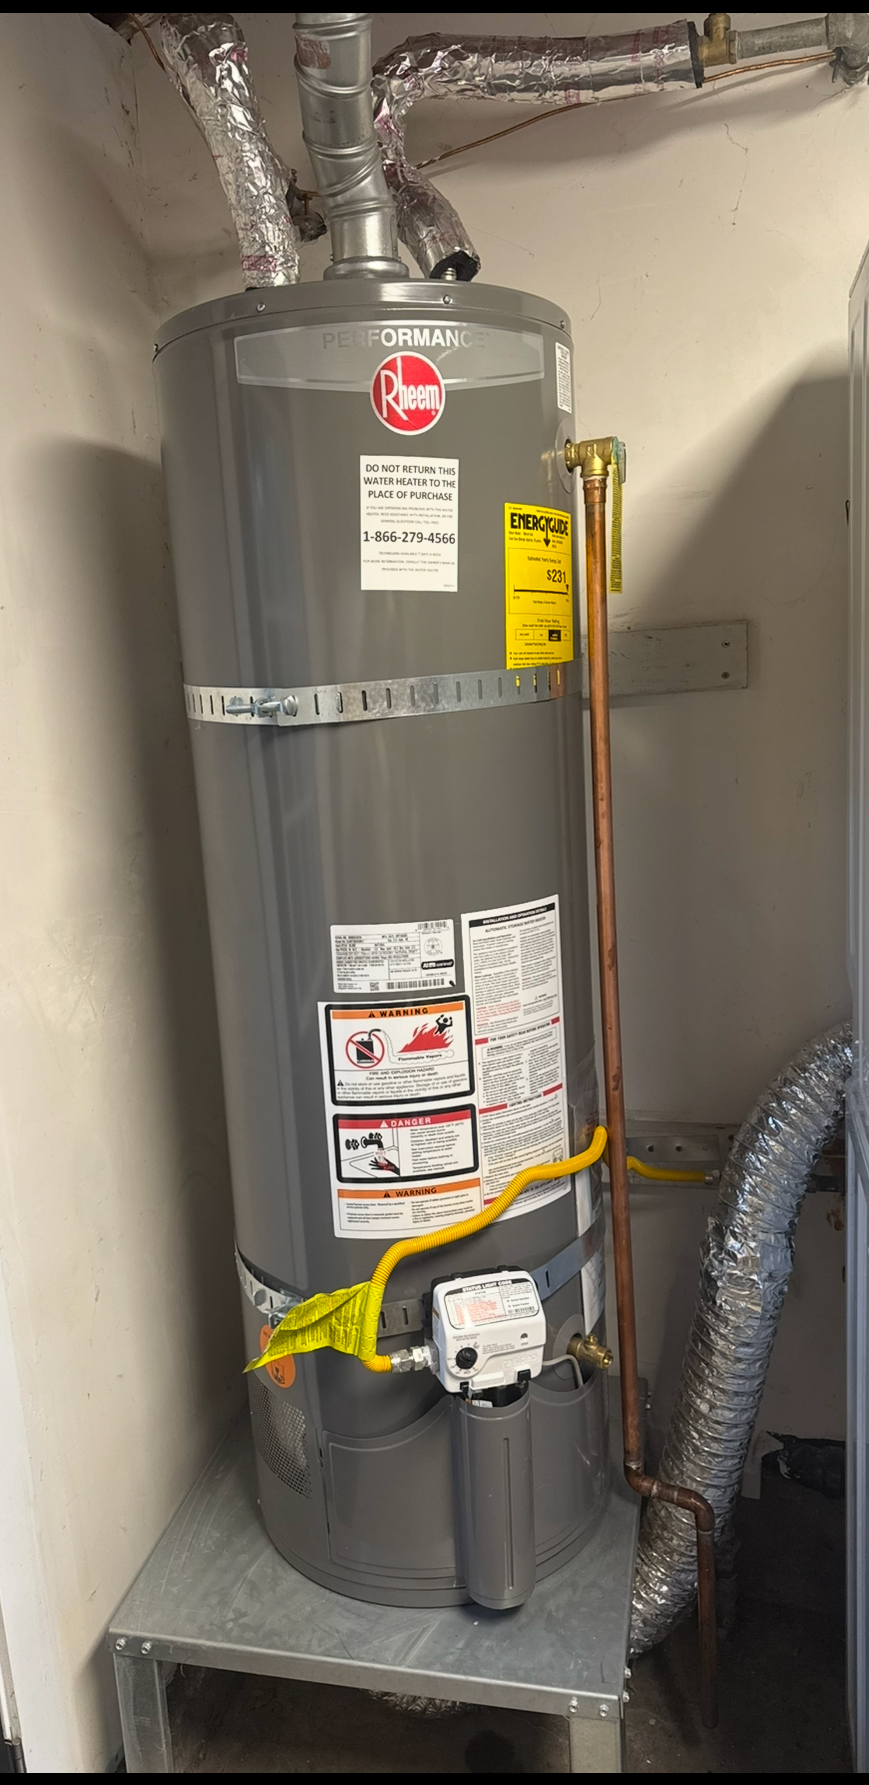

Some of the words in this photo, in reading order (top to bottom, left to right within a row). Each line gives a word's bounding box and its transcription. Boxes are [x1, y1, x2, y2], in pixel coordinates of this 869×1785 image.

[322, 328, 486, 349] PERFORMANCE
[379, 356, 440, 420] Rheem
[366, 464, 379, 472] DO
[382, 465, 400, 473] NOT
[403, 465, 436, 474] RETURN
[438, 467, 456, 475] THIS
[363, 477, 394, 485] WATER
[396, 478, 427, 487] HEATER
[429, 479, 440, 487] TO
[442, 480, 456, 488] THE
[368, 490, 394, 499] PLACE
[396, 491, 408, 499] OF
[410, 491, 453, 501] PURCHASE
[510, 512, 568, 536] ENERGYGUIDE
[363, 531, 455, 544] 1-866-279-4566
[547, 569, 566, 584] $231
[379, 1008, 429, 1017] WARNING
[390, 1118, 431, 1127] DANGER
[395, 1187, 437, 1197] WARNING
